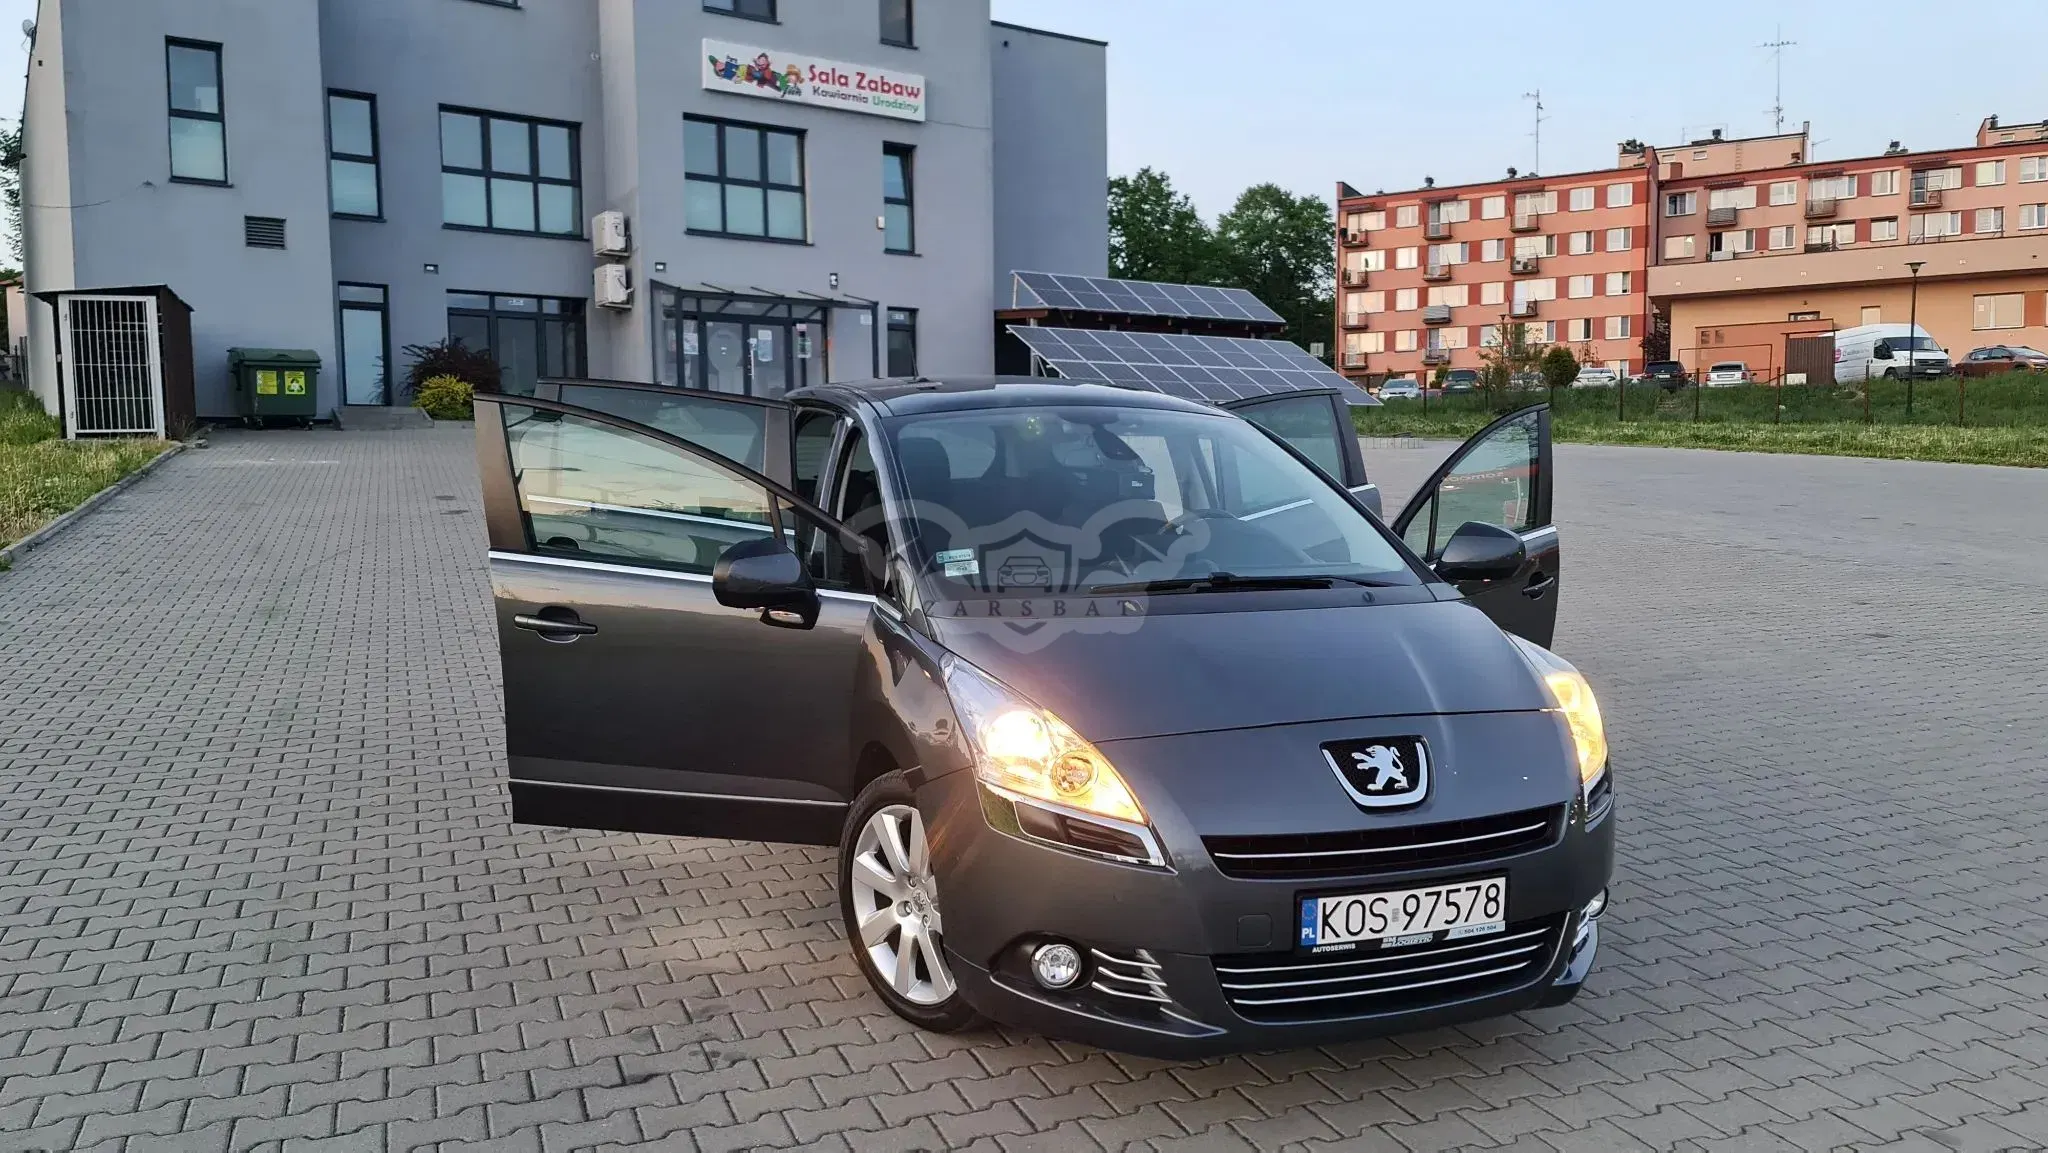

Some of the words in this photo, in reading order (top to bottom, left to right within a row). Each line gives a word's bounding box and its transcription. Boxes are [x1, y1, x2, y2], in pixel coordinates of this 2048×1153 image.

[808, 64, 849, 88] Sala
[855, 71, 921, 98] Zabaw
[811, 85, 869, 104] Kawiarnia
[872, 95, 919, 113] Urodziny
[1321, 897, 1389, 940] KOS
[1402, 883, 1500, 931] 97578
[1301, 927, 1316, 939] PL
[1312, 943, 1356, 954] AUTOSERWIS
